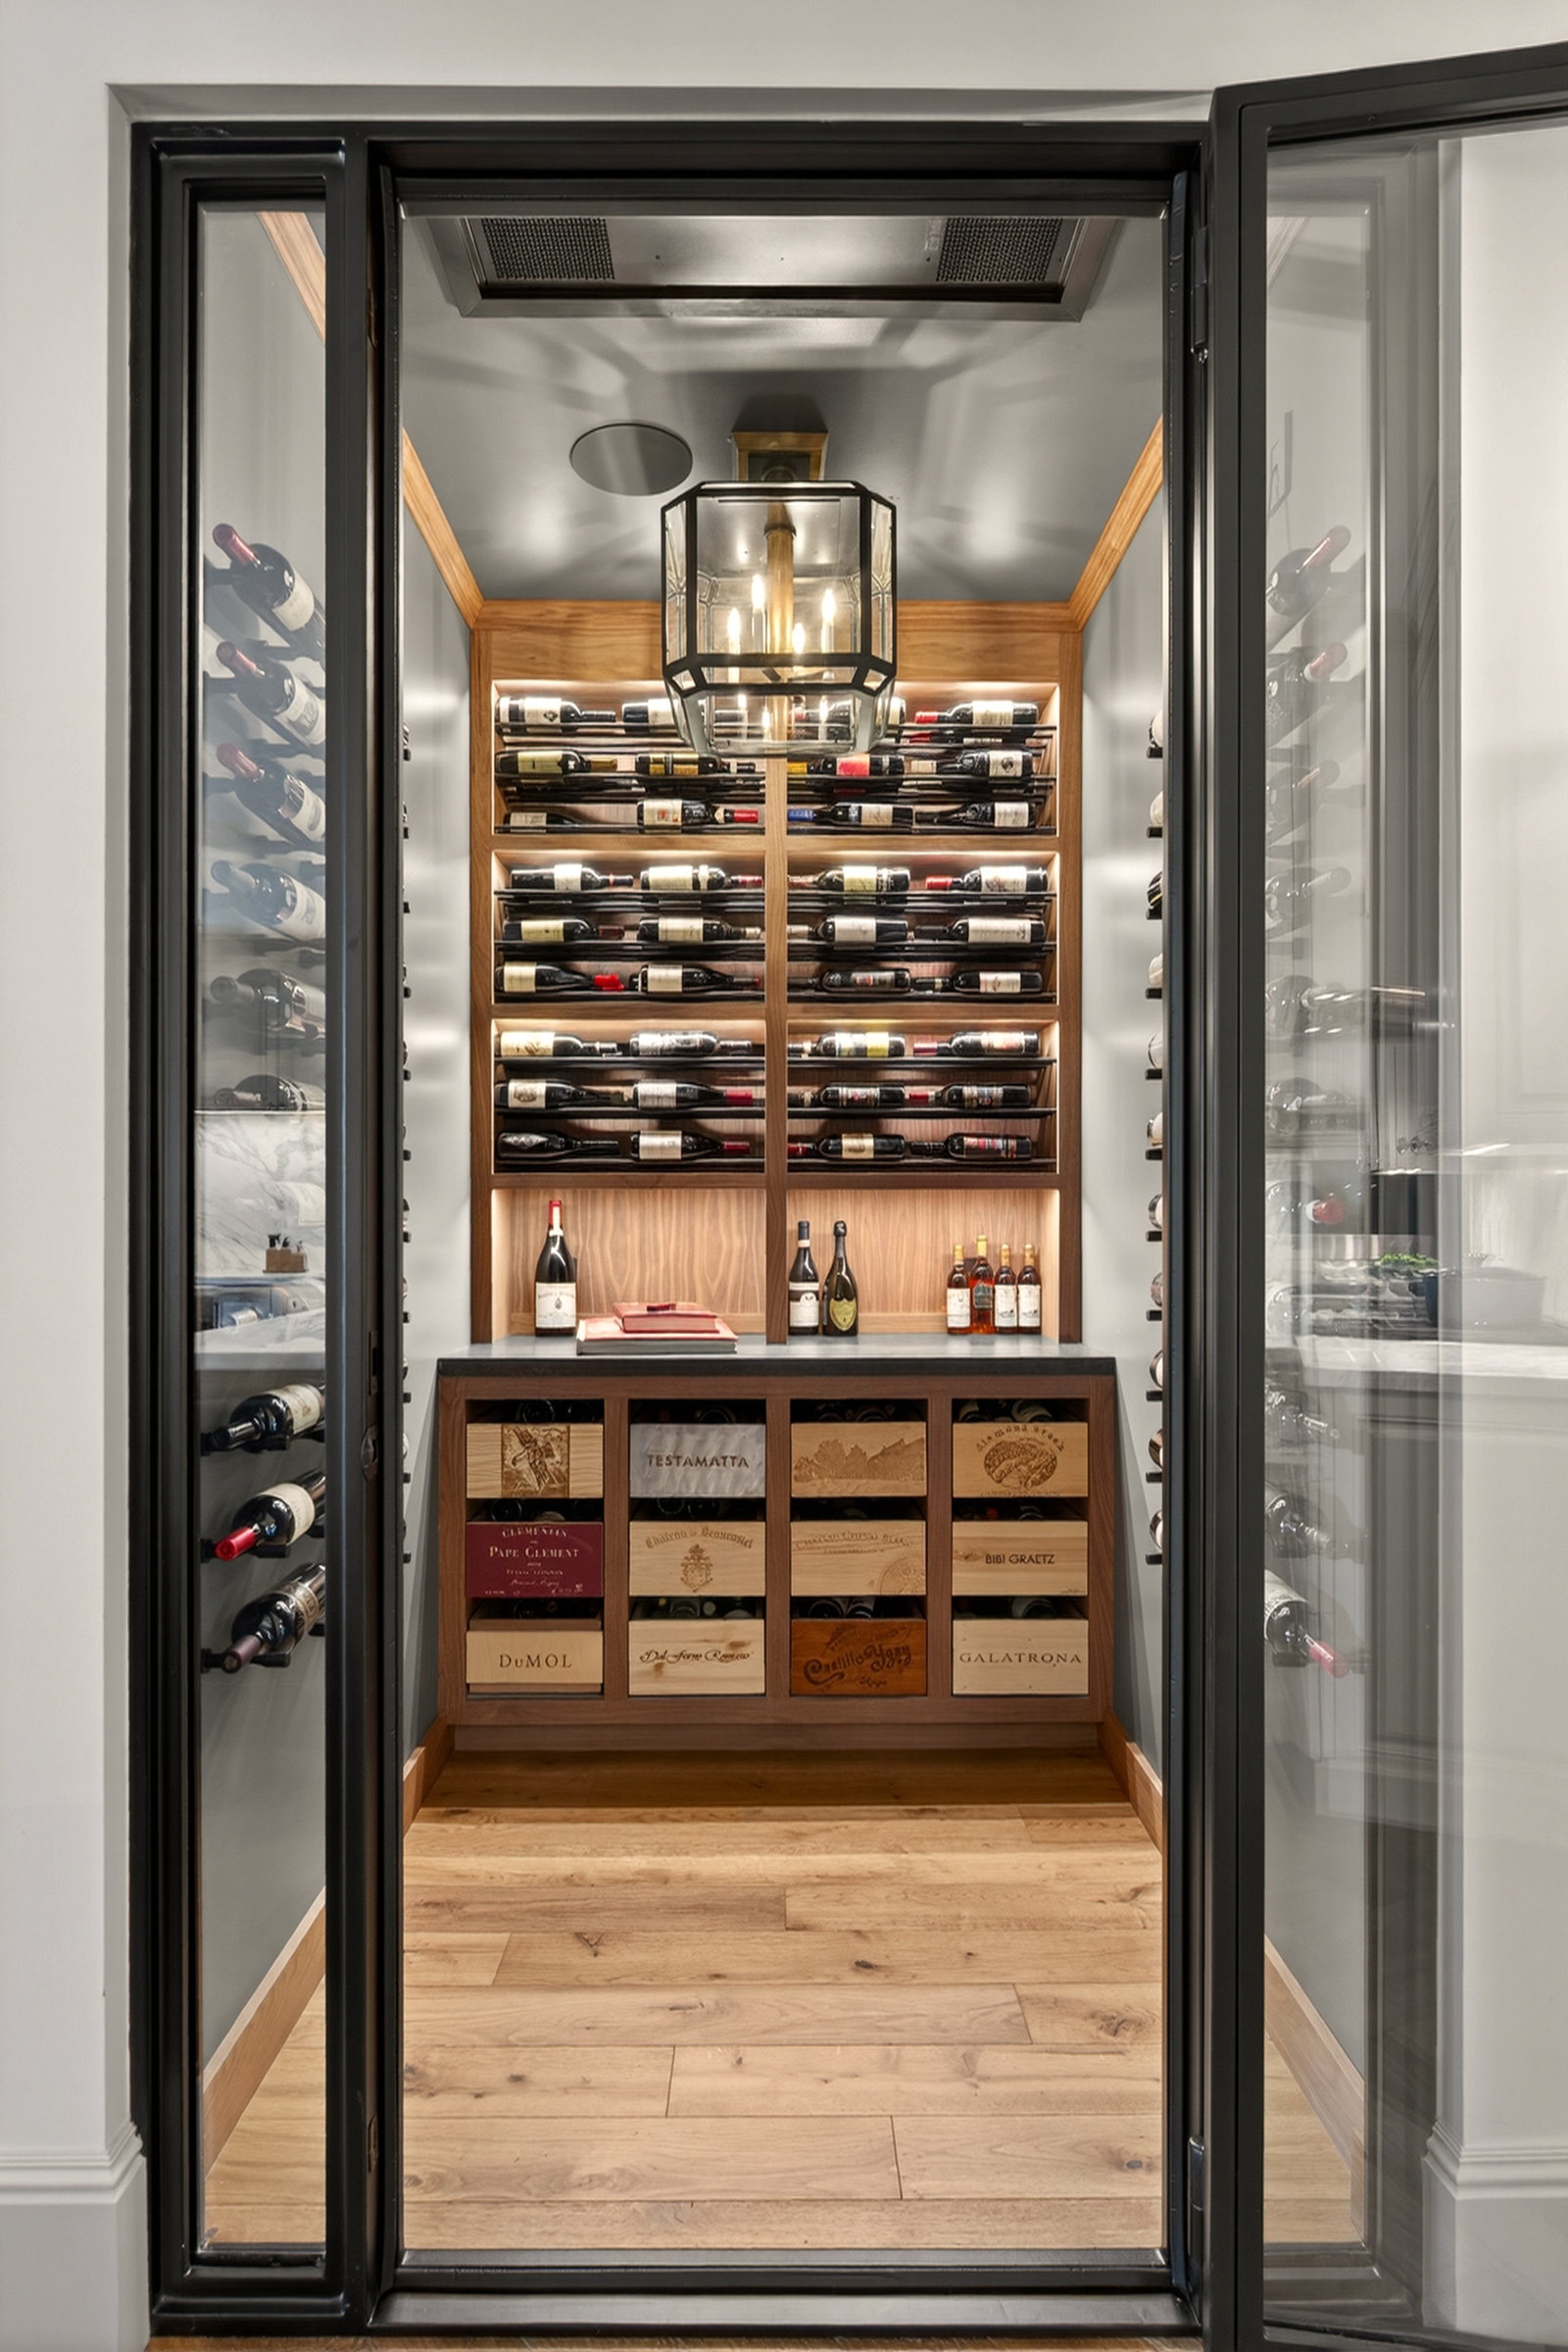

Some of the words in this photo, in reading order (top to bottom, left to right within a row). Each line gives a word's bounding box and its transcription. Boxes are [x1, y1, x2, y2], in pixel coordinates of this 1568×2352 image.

[647, 1454, 750, 1468] TESTAMATTA
[985, 1553, 1005, 1565] BIBI
[1008, 1553, 1055, 1565] GRAETZ
[499, 1653, 572, 1668] DuMOL
[959, 1652, 1082, 1664] GALATRONA
